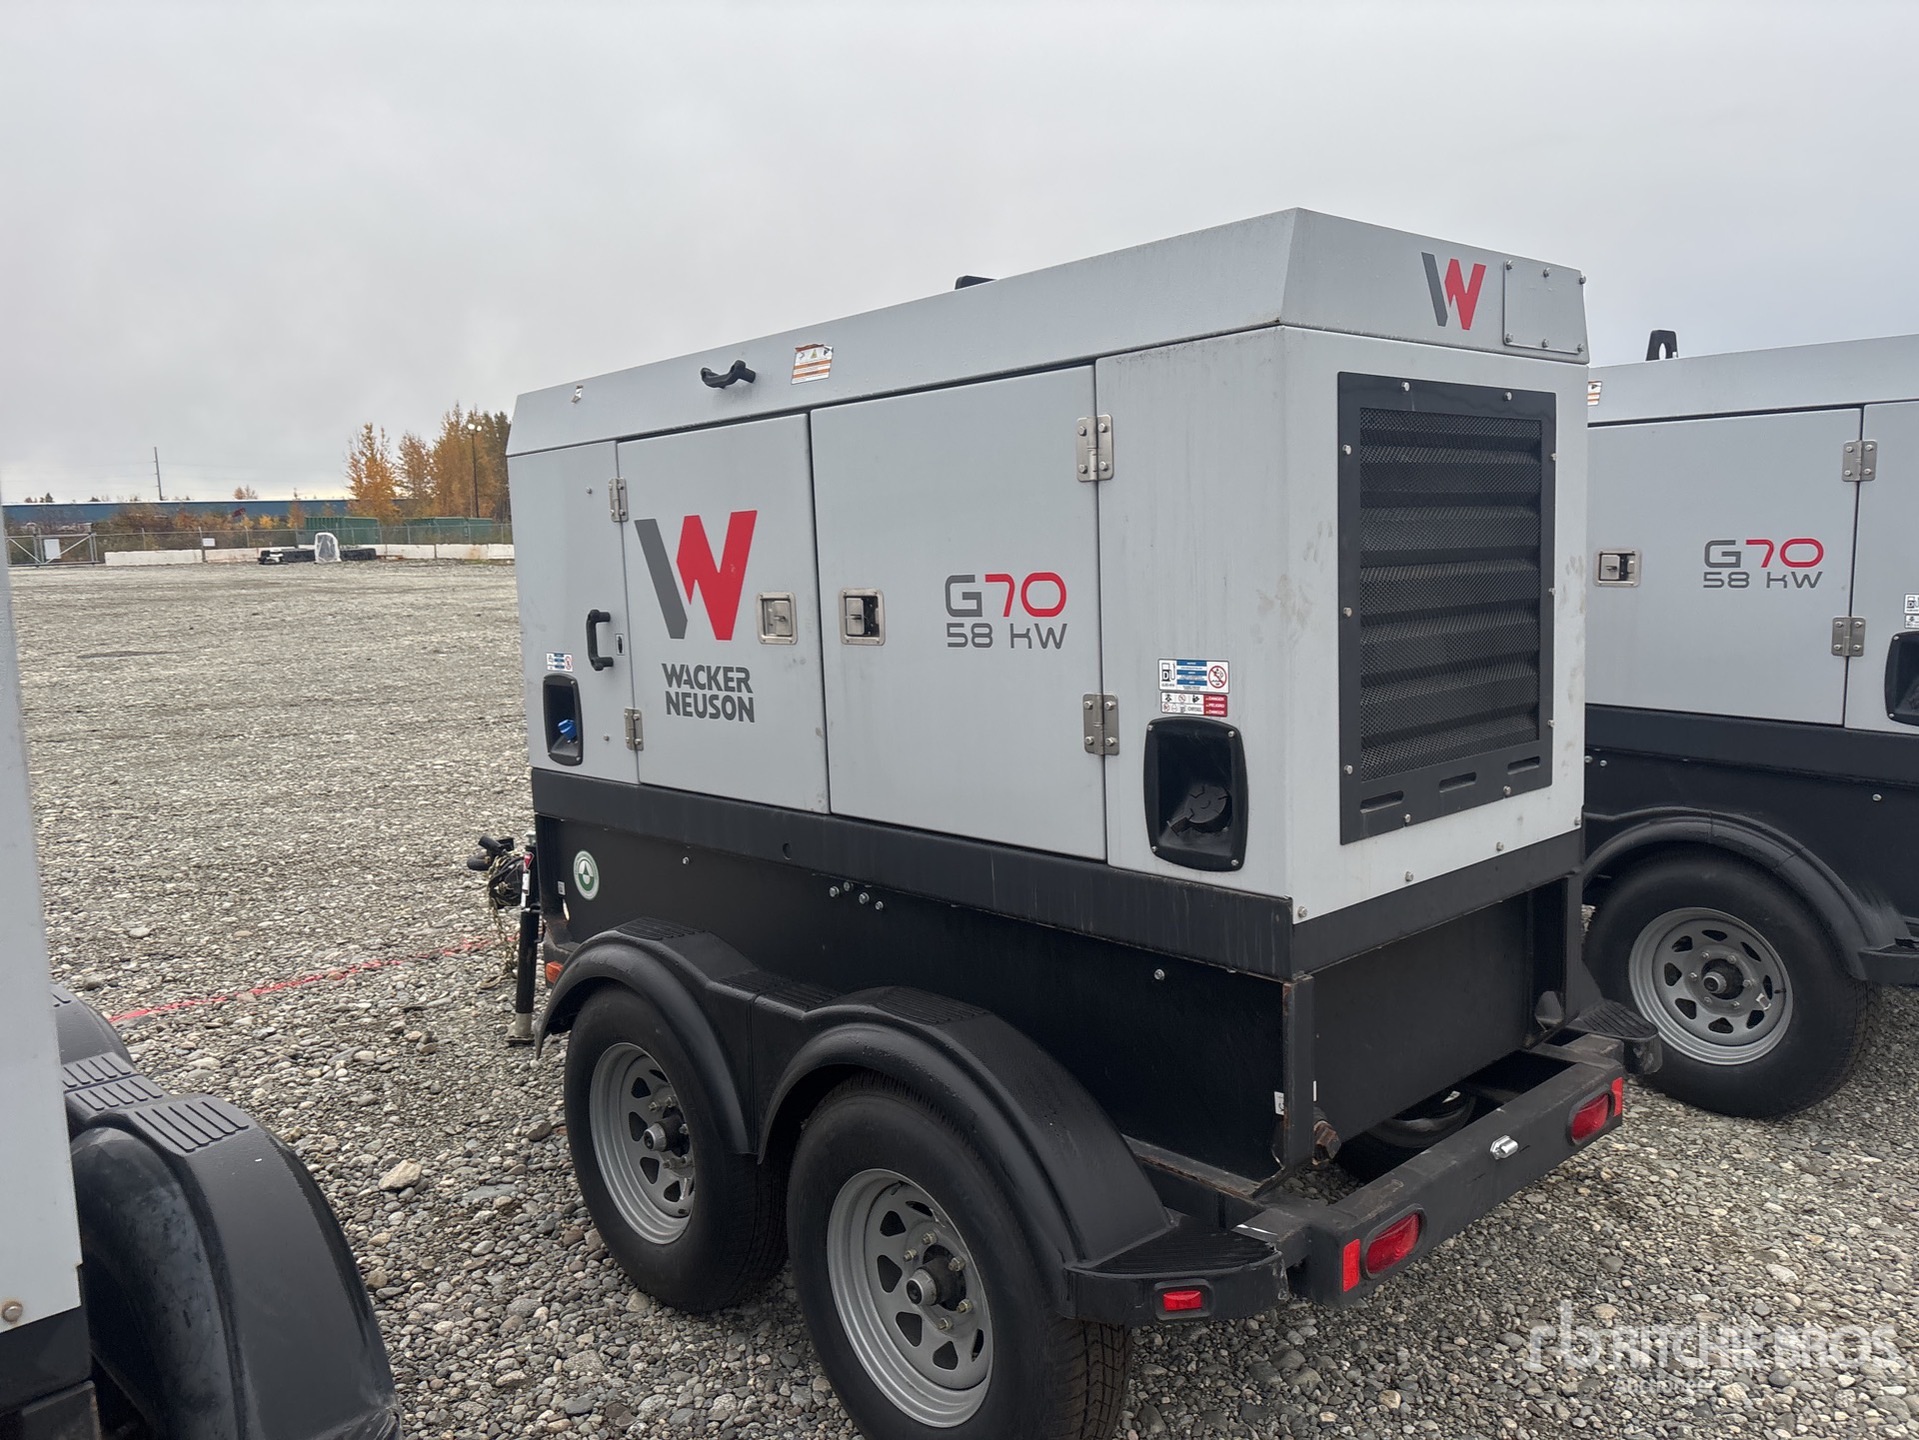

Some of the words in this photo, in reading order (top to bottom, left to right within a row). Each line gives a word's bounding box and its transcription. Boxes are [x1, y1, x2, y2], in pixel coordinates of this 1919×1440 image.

[1704, 538, 1824, 568] G70
[945, 572, 1067, 617] G70
[1703, 571, 1750, 588] 58
[946, 622, 993, 648] 58
[661, 663, 753, 693] WACKER
[665, 691, 755, 723] NEUSON
